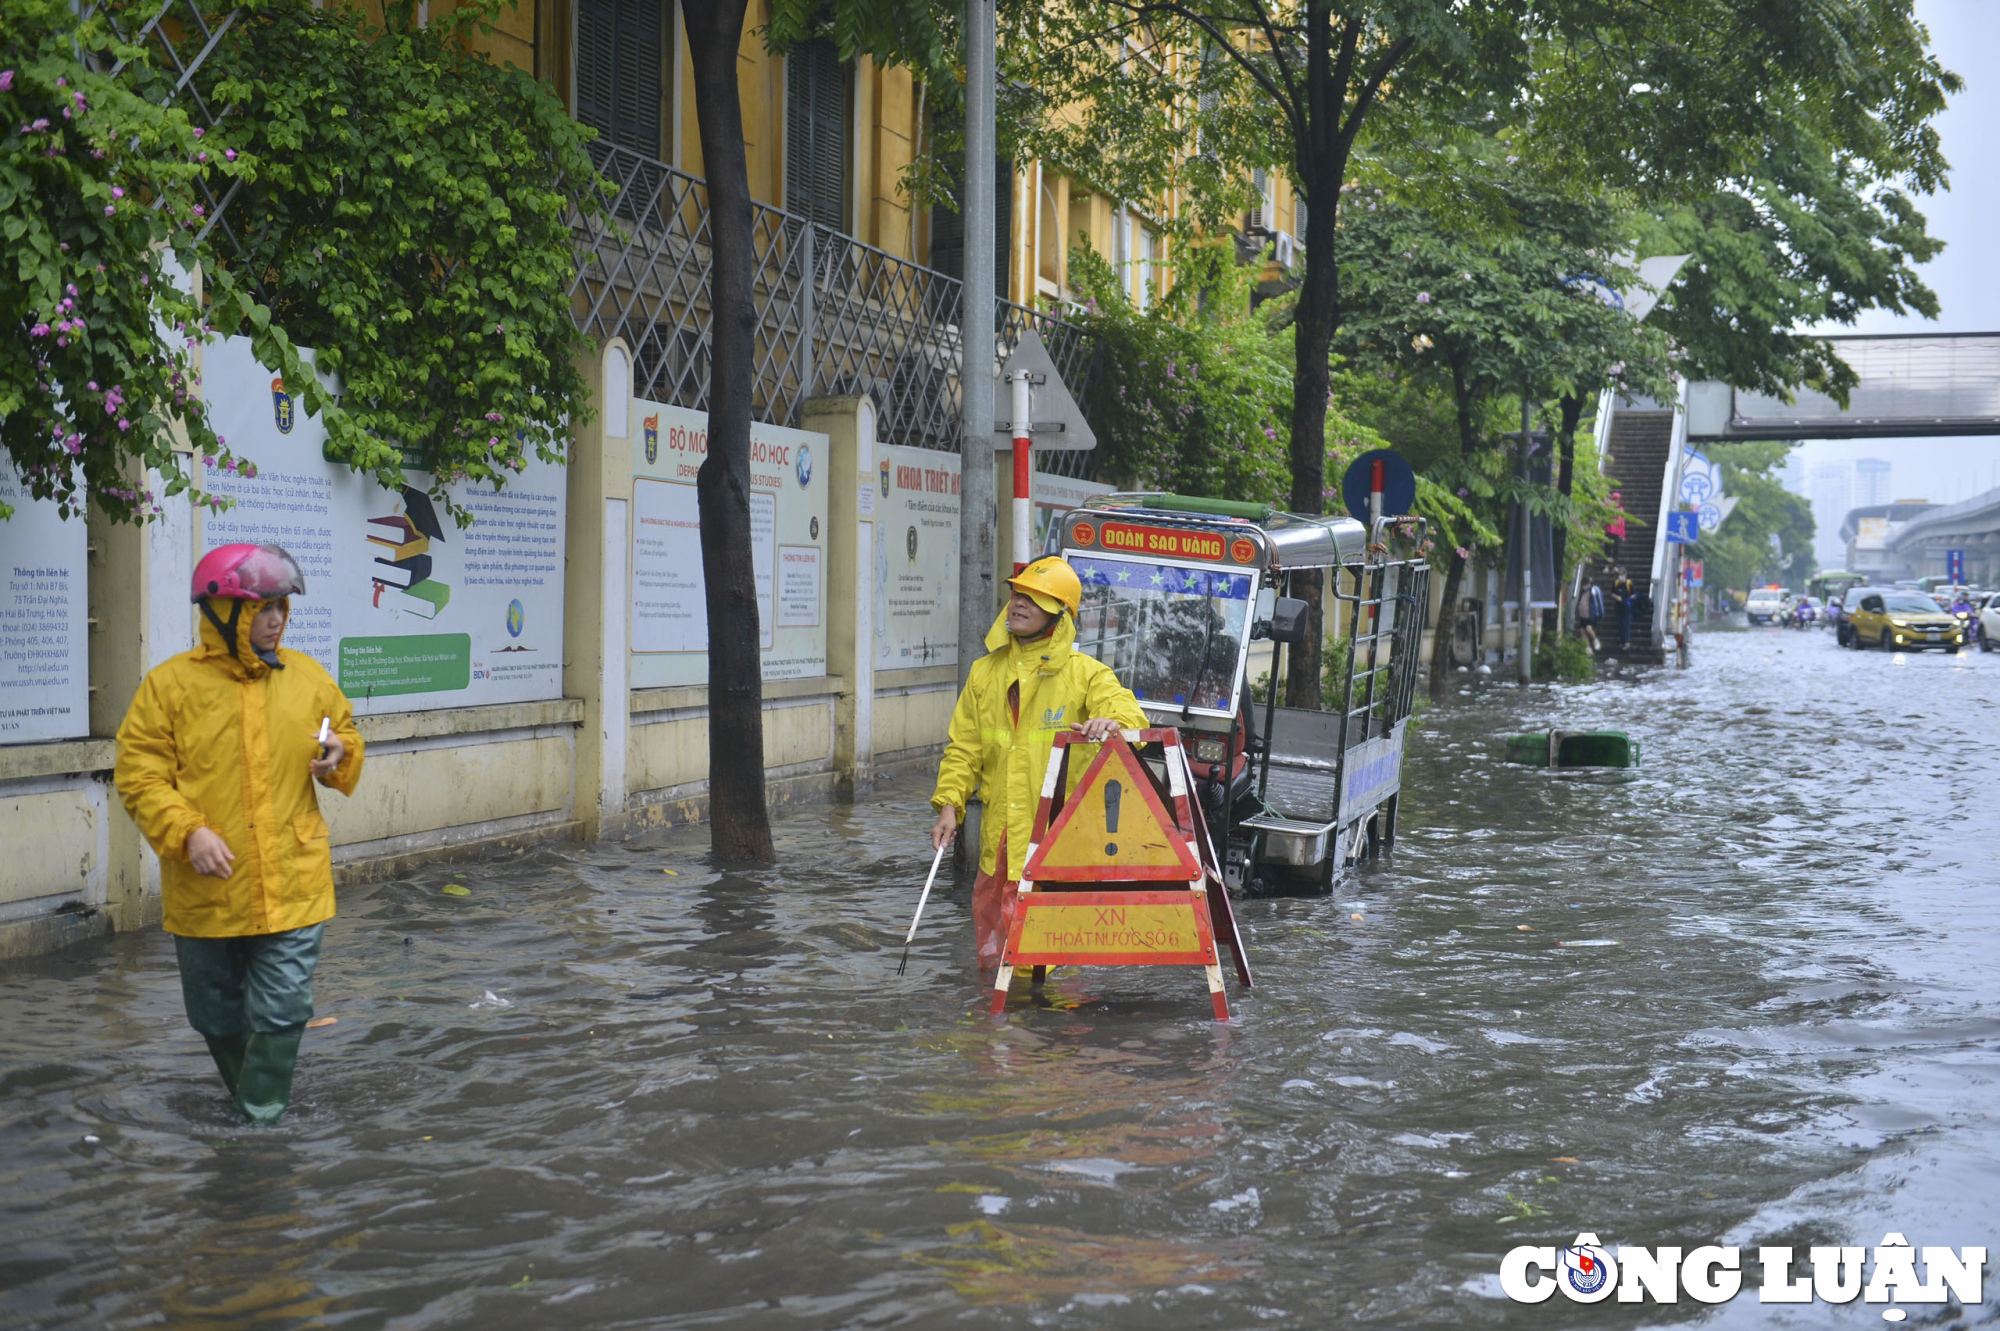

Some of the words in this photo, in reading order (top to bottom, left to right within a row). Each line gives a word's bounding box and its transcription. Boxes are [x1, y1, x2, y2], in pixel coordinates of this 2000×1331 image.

[670, 425, 686, 456] BỘ
[688, 428, 708, 454] MÔ
[768, 444, 789, 470] HỌC
[280, 472, 291, 484] học
[897, 466, 922, 491] KHOA
[925, 464, 949, 494] TRIẾT
[952, 473, 961, 500] HỌ
[252, 484, 260, 494] ba
[272, 486, 284, 498] học
[208, 520, 216, 532] Có
[294, 526, 300, 536] 65
[1105, 529, 1144, 548] ĐOÀN
[1150, 536, 1177, 551] SAO
[1182, 536, 1220, 556] VÀNG
[14, 566, 35, 578] Thông
[36, 568, 45, 577] tin
[46, 568, 58, 577] liên
[14, 595, 22, 604] 75
[16, 707, 30, 717] PHÁT
[58, 706, 71, 714] NAM
[1094, 908, 1126, 926] XN
[1044, 927, 1094, 947] THOÁT
[1095, 926, 1142, 947] NƯỚC
[1168, 931, 1179, 946] 6
